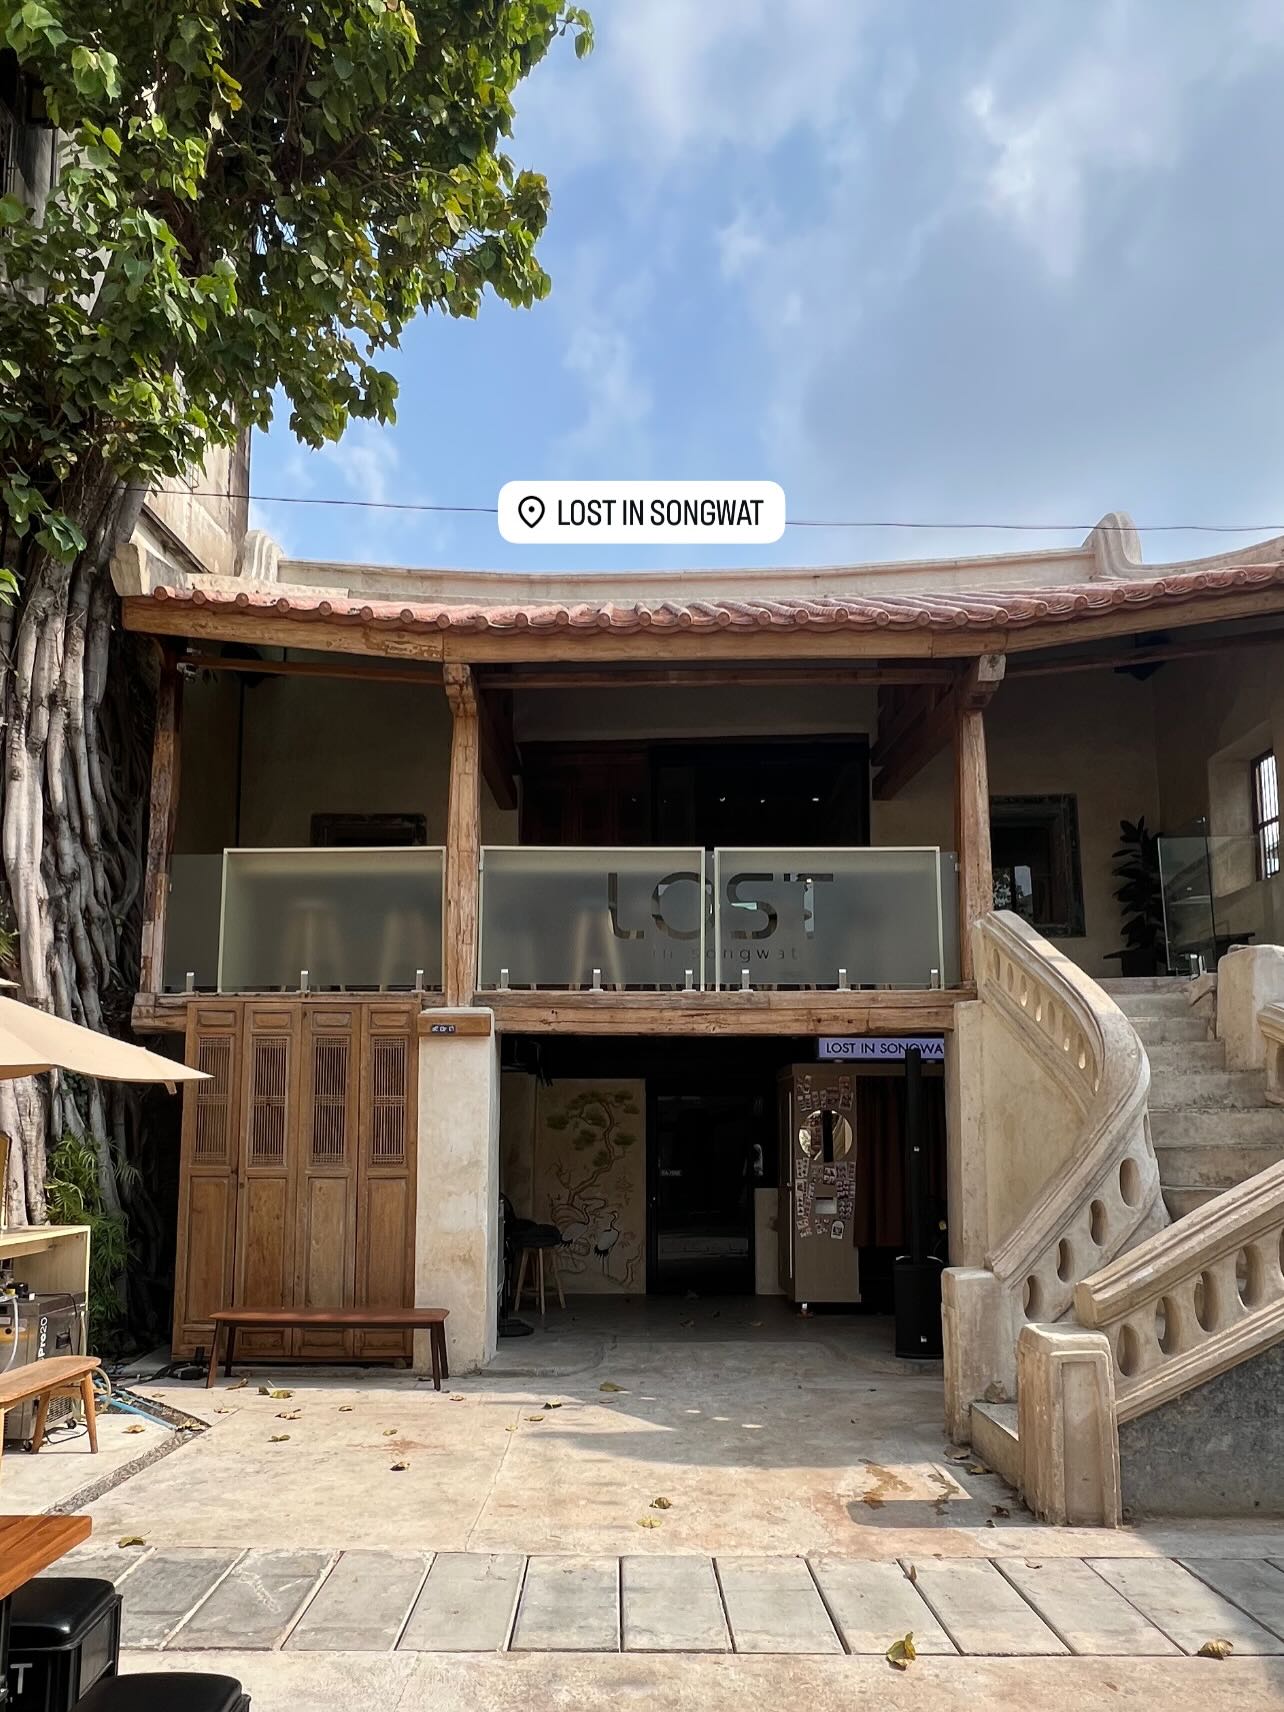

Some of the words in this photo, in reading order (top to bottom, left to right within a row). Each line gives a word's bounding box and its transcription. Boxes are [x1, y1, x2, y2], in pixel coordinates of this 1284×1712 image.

[607, 871, 834, 941] LOST
[826, 1042, 856, 1054] LOST
[860, 1042, 875, 1054] IN
[880, 1042, 944, 1055] SONGWA
